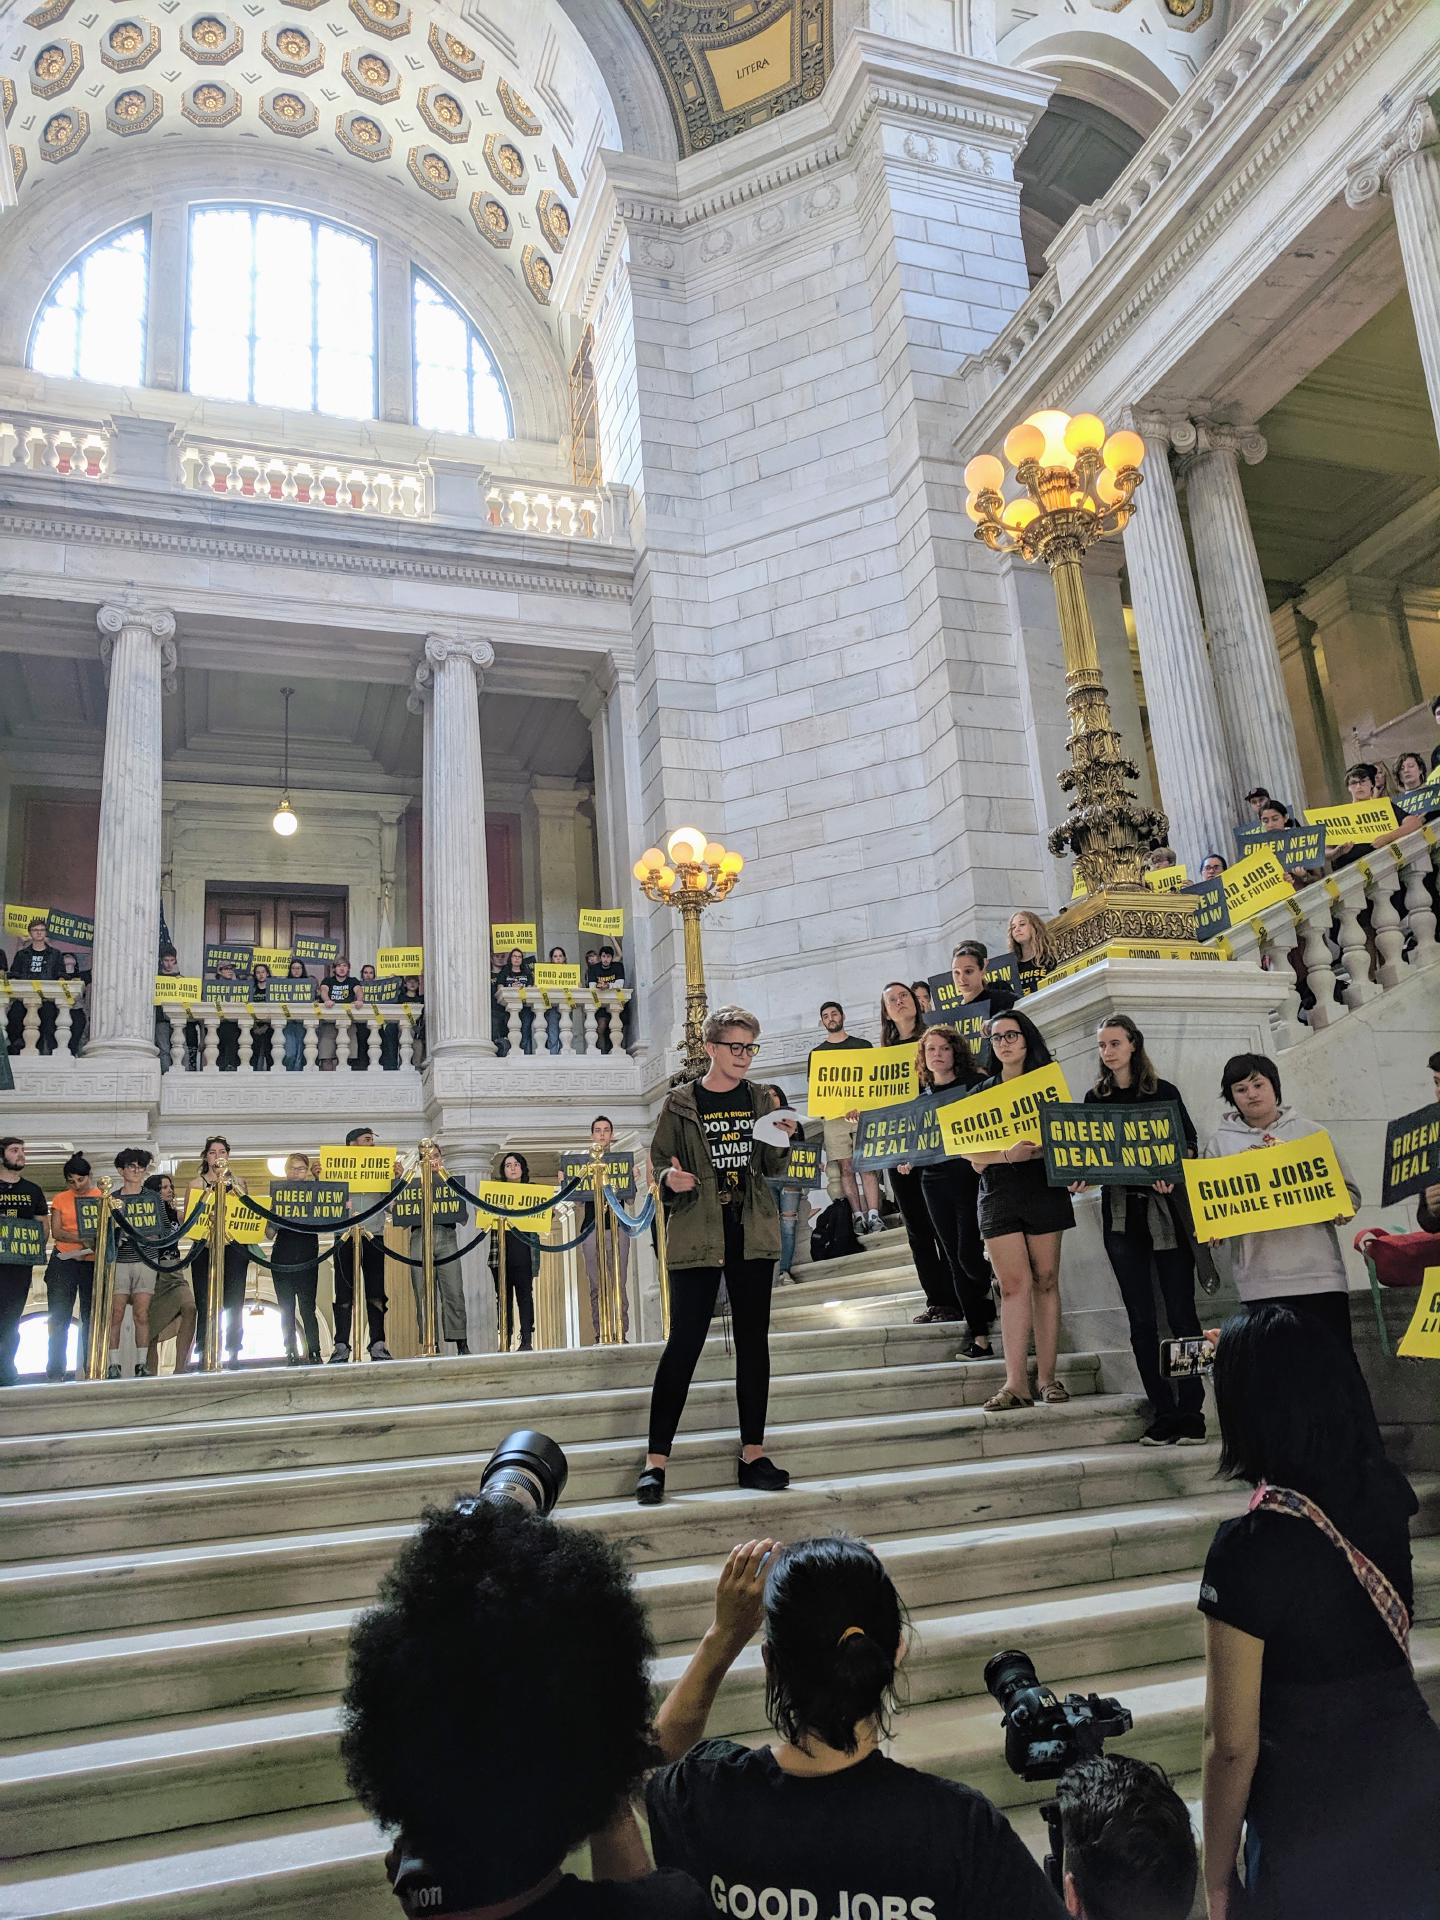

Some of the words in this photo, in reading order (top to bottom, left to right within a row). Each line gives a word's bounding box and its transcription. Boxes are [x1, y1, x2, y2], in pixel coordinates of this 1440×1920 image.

[736, 58, 770, 79] LITERA
[1356, 810, 1390, 825] JOBS
[1290, 833, 1319, 850] NEW
[1286, 848, 1319, 864] NOW
[1158, 875, 1182, 889] JOBS
[1242, 862, 1276, 889] JOBS
[1248, 874, 1282, 898] FUTURE
[50, 914, 75, 927] GREEN
[77, 921, 94, 932] NEW
[49, 924, 70, 937] DEAL
[73, 930, 94, 940] NOW
[297, 941, 320, 950] GREEN
[321, 943, 337, 952] NEW
[208, 950, 231, 959] GREEN
[233, 952, 249, 960] NEW
[296, 949, 316, 958] DEAL
[318, 952, 336, 960] NOW
[178, 984, 198, 992] JOBS
[818, 1066, 863, 1083] GOOD
[869, 1062, 910, 1082] JOBS
[817, 1085, 865, 1098] LIVABLE
[869, 1082, 910, 1097] FUTURE
[704, 1112, 723, 1120] HAVE
[951, 1108, 1003, 1135] GOOD
[866, 1112, 917, 1139] GREEN
[953, 1125, 1010, 1146] LIVABLE
[1014, 1116, 1040, 1134] FUT
[1050, 1120, 1115, 1141] GREEN
[1124, 1119, 1169, 1141] NEW
[722, 1133, 740, 1141] AND
[1393, 1121, 1440, 1160] GREEN
[864, 1134, 909, 1158] DEAL
[326, 1157, 356, 1169] GOOD
[360, 1158, 390, 1169] JOBS
[792, 1150, 816, 1164] NEW
[1054, 1147, 1114, 1168] DEAL
[1121, 1144, 1175, 1167] NOW
[325, 1171, 357, 1179] LIVABLE
[360, 1171, 390, 1180] FUTURE
[788, 1166, 816, 1179] NOW
[1391, 1151, 1430, 1186] DEAL
[1198, 1172, 1260, 1202] GOOD
[1268, 1157, 1329, 1189] JOBS
[276, 1190, 313, 1203] GREEN
[317, 1191, 344, 1204] NEW
[484, 1193, 514, 1205] GOOD
[1204, 1196, 1270, 1221] LIVABLE
[1274, 1182, 1336, 1208] FUTURE
[127, 1203, 154, 1214] NEW
[276, 1205, 307, 1218] DEAL
[313, 1206, 343, 1218] NOW
[432, 1201, 459, 1214] NOW
[228, 1220, 261, 1231] FUTURE
[14, 1227, 38, 1240] NEW
[11, 1241, 40, 1255] NOW
[710, 1874, 818, 1920] GOOD
[830, 1890, 937, 1920] JOBS
